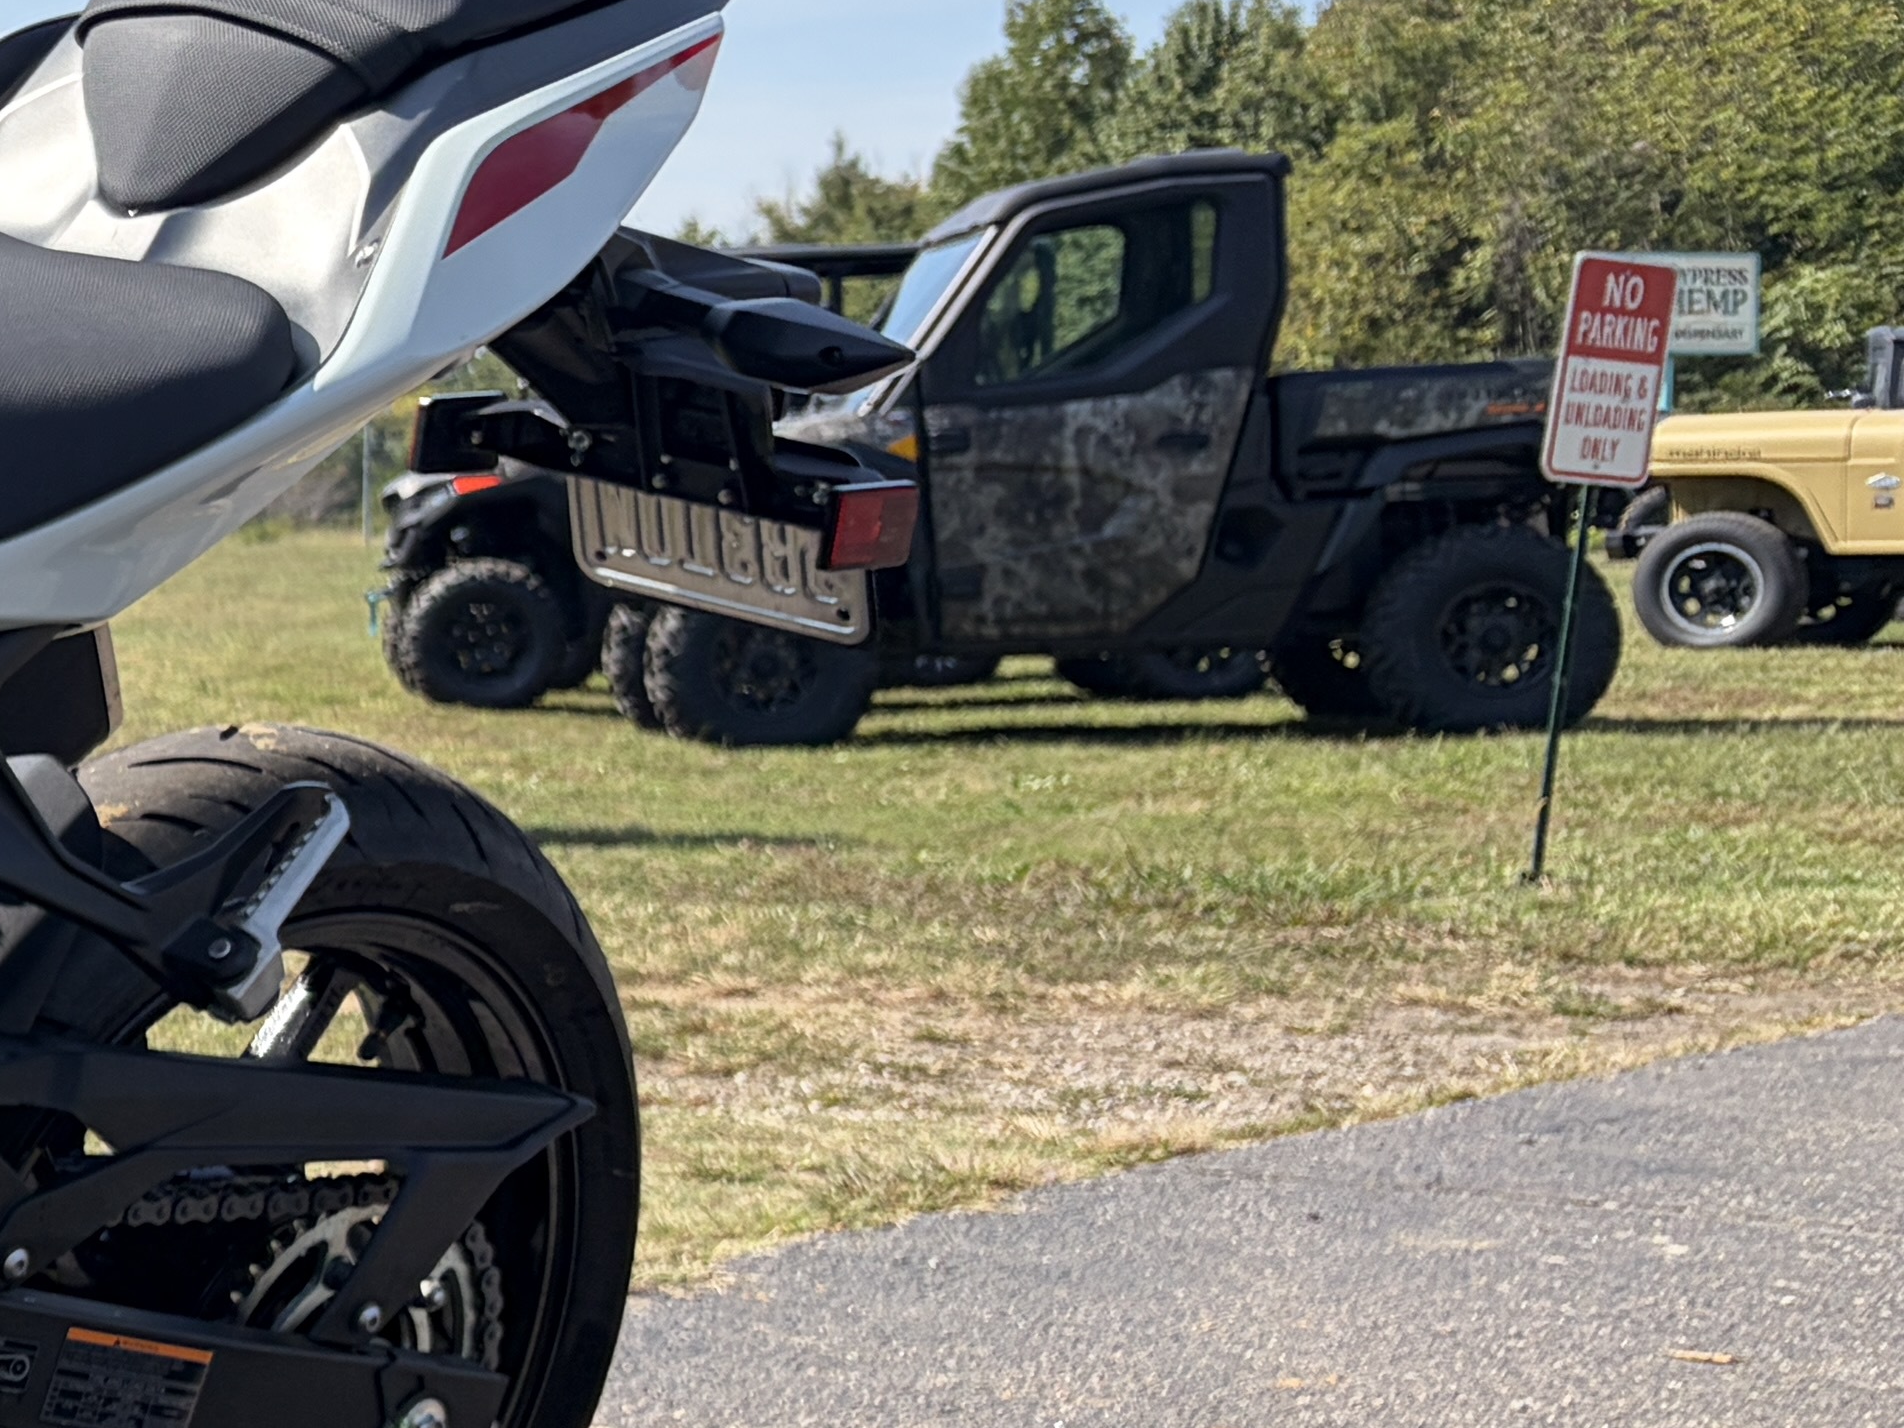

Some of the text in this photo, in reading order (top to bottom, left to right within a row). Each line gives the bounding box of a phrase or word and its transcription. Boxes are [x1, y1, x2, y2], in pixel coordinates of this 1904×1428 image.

[1601, 271, 1645, 311] NO
[1575, 310, 1661, 353] PARKING
[1569, 366, 1633, 399] LOADING
[1564, 399, 1646, 433] UNLOADING
[1579, 435, 1621, 463] ONLY
